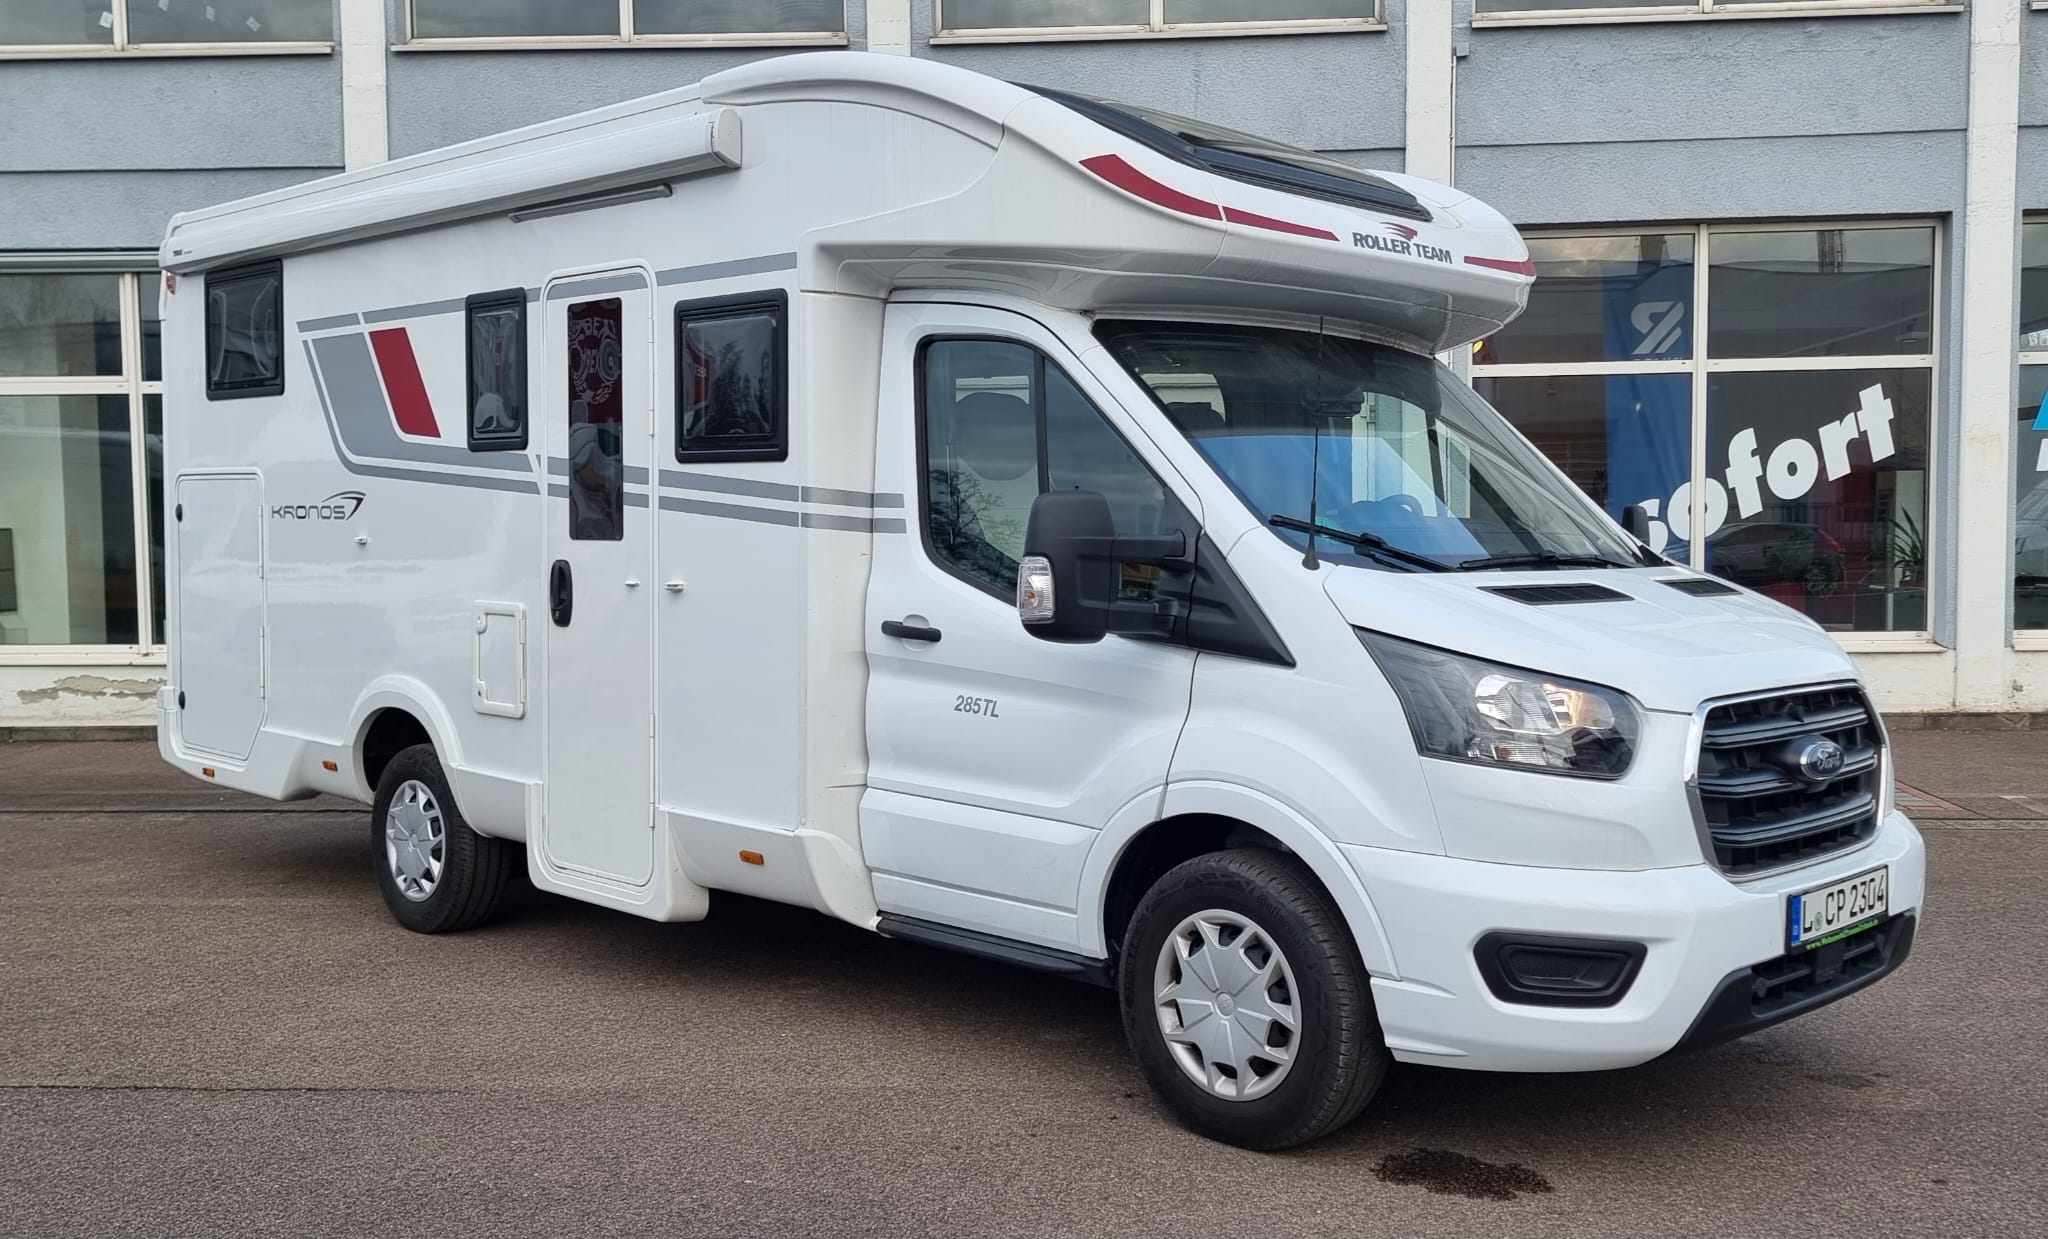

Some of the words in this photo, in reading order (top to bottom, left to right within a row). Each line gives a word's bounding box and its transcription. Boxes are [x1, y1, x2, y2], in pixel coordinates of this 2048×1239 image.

[1352, 231, 1412, 256] ROLLER
[1413, 242, 1453, 264] TEAM
[271, 504, 346, 520] KRONOS
[953, 694, 1000, 718] 285TL
[1802, 899, 1814, 934] L
[1825, 888, 1847, 926] CP
[1849, 874, 1885, 918] 2304
